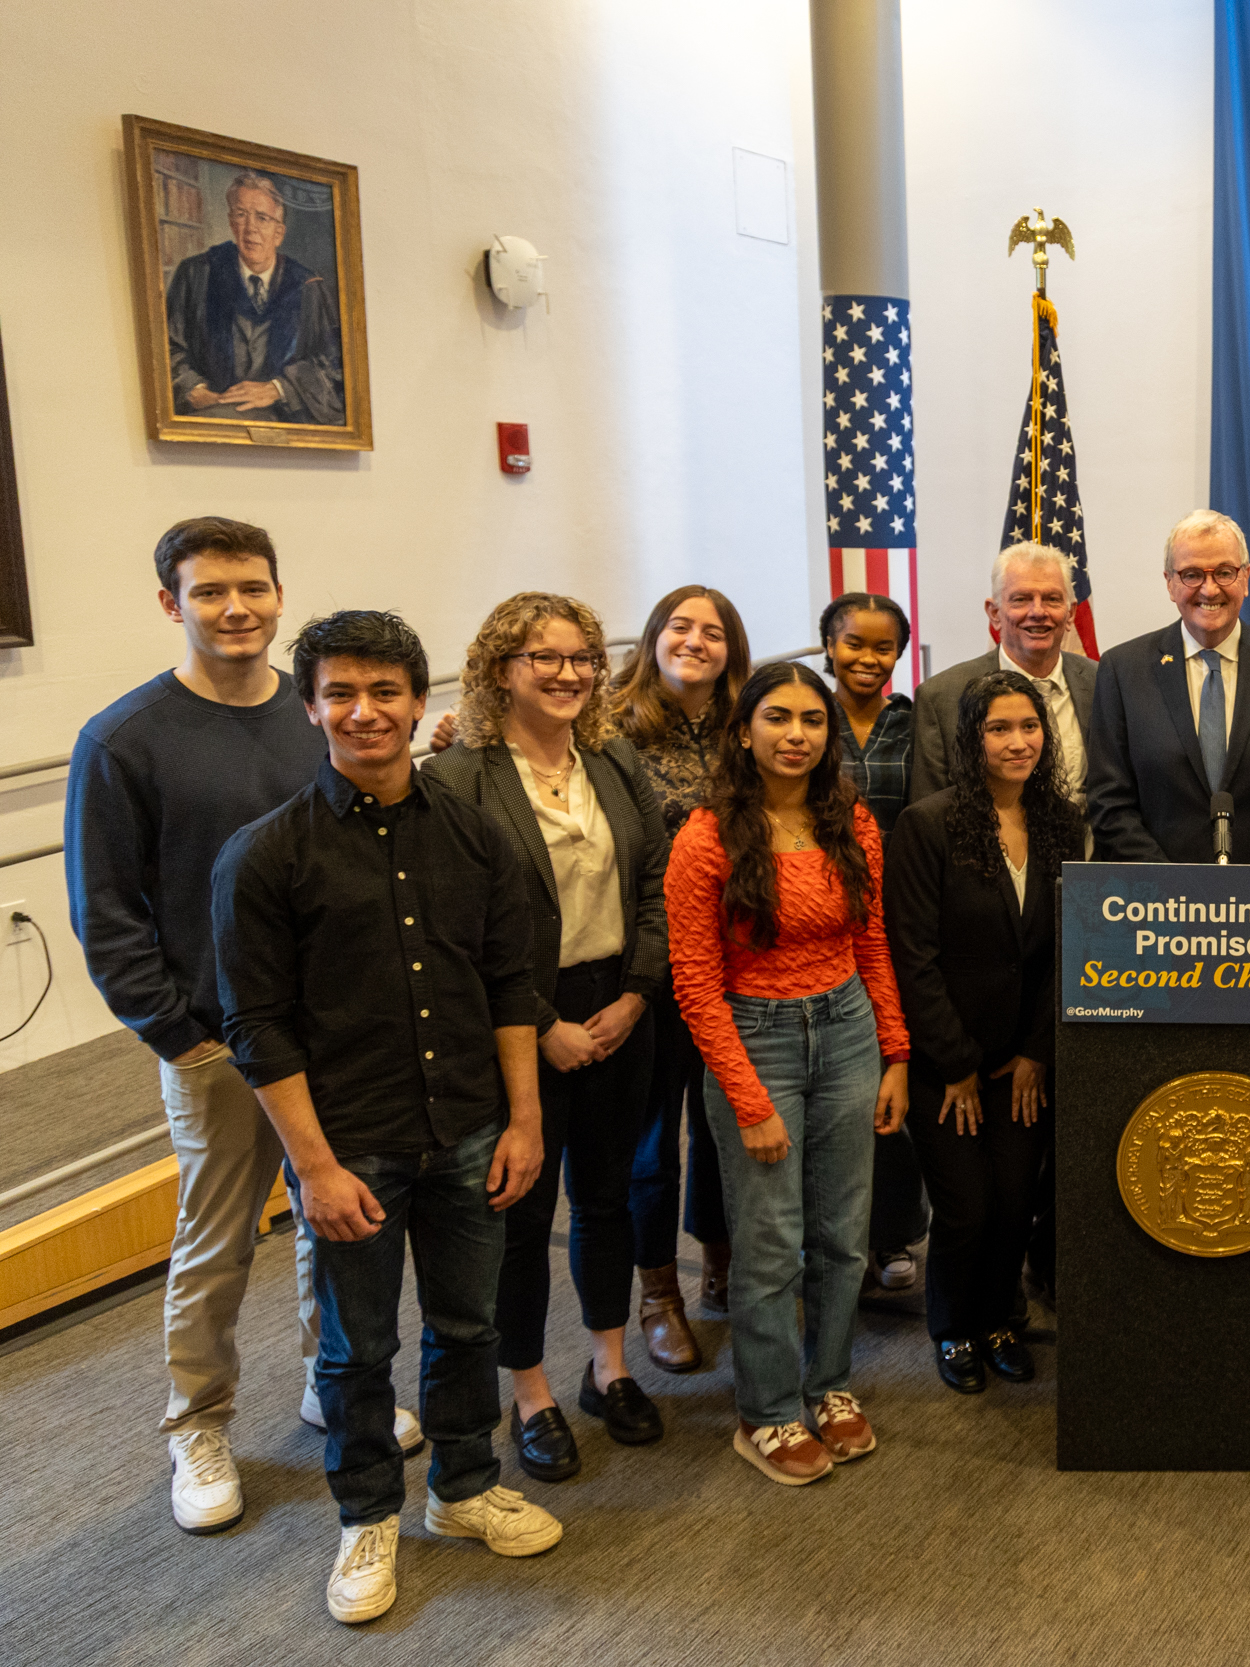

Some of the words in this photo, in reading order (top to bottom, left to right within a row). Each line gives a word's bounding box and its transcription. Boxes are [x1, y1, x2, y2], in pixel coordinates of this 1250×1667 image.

[1080, 960, 1205, 988] Second
[1066, 1006, 1145, 1019] @GovMurphy
[1167, 1091, 1185, 1108] OF
[1189, 1085, 1221, 1099] THE
[1138, 1106, 1167, 1135] SEAL
[1127, 1136, 1144, 1181] GREAT
[1130, 1184, 1150, 1214] THE
